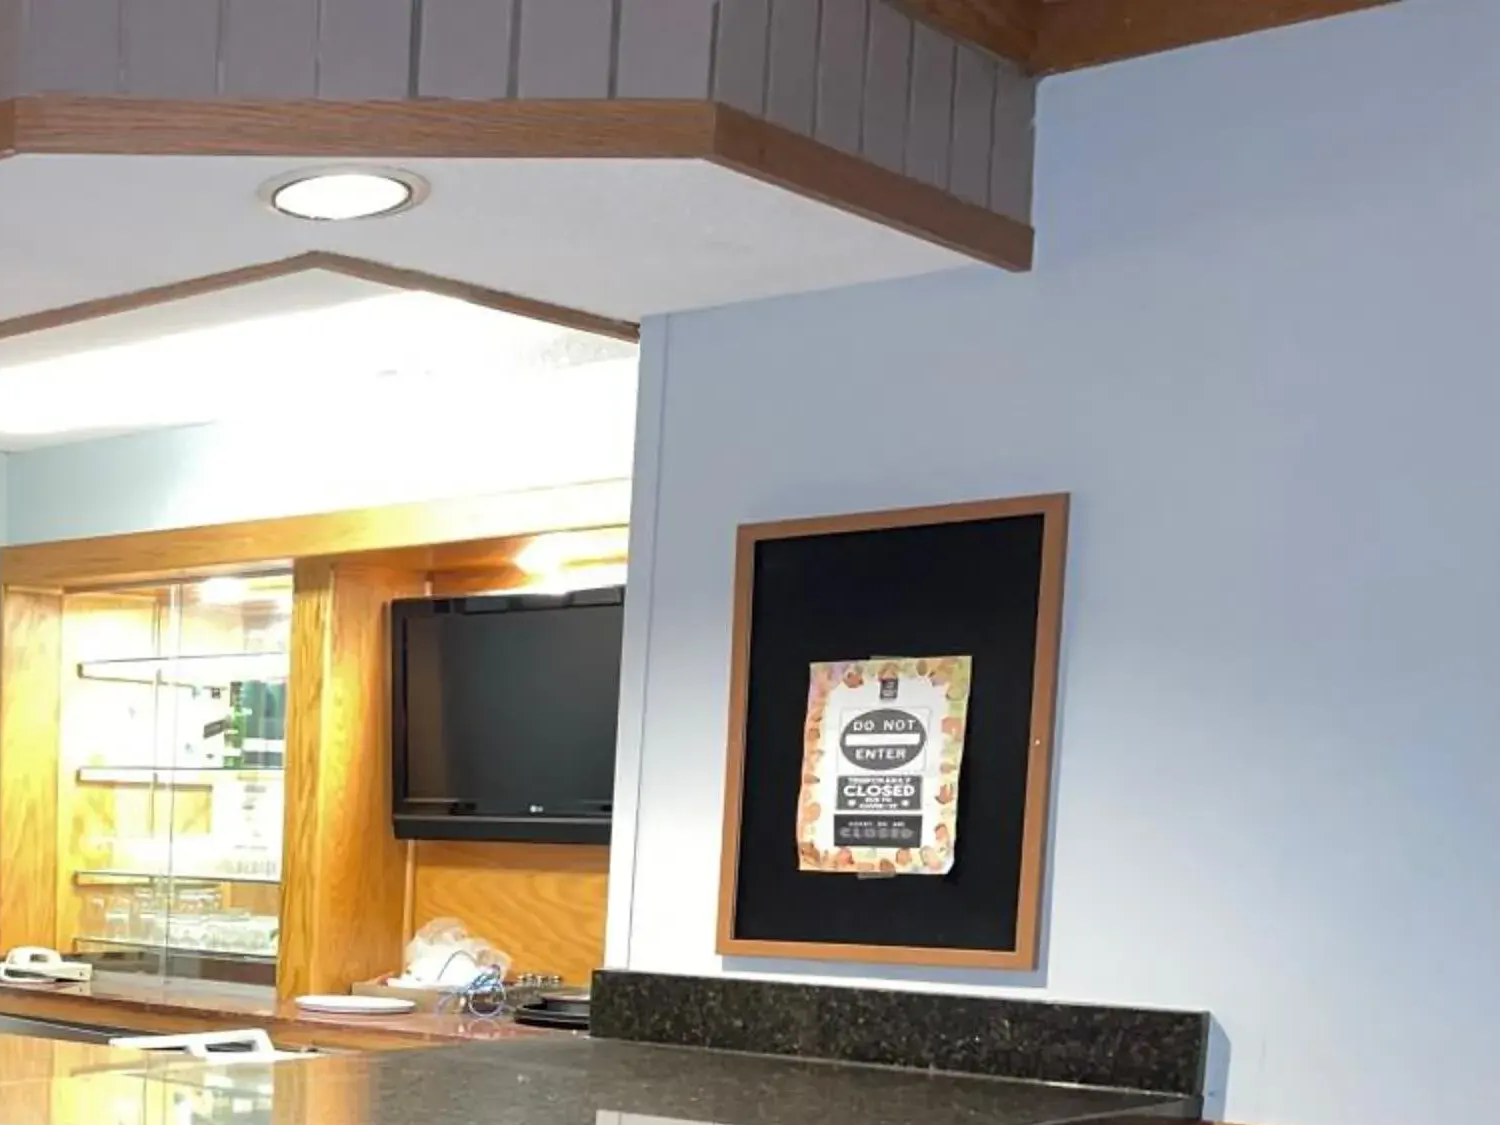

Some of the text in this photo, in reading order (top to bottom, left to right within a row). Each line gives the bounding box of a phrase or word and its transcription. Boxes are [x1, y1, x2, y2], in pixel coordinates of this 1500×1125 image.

[853, 719, 916, 731] DO NOT
[855, 747, 906, 760] ENTER
[843, 784, 915, 797] CLOSED
